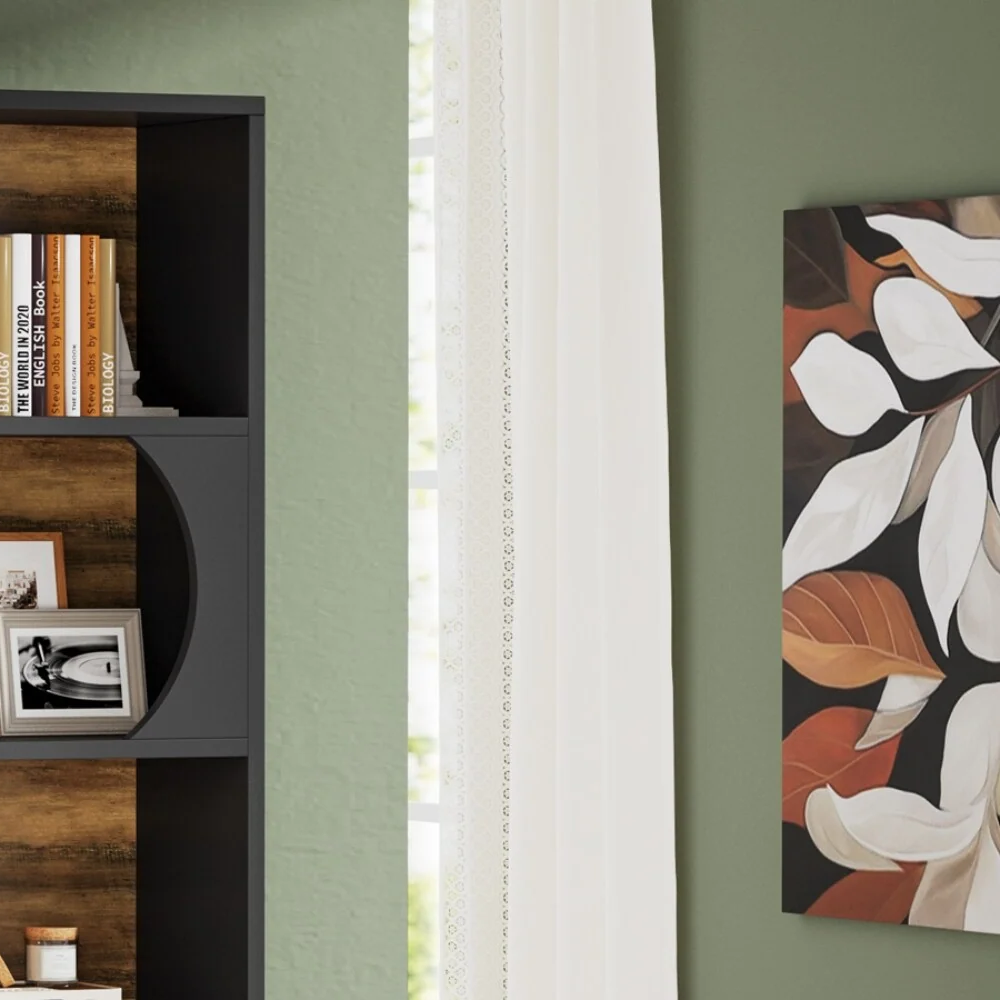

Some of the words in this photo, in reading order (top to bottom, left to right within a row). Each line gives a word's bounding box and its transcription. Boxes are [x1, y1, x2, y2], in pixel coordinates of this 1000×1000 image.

[33, 280, 45, 316] Book
[52, 292, 60, 329] Walter
[86, 292, 96, 329] Walter
[18, 305, 29, 334] 2020
[17, 337, 29, 348] IN
[52, 335, 63, 347] by
[88, 335, 97, 347] by
[33, 325, 45, 387] ENGLISH
[52, 356, 60, 376] Jobs
[88, 356, 96, 376] Jobs
[17, 351, 29, 390] WORLD
[102, 353, 114, 412] BIOLOGY
[17, 393, 29, 413] THE
[51, 385, 60, 413] Steve
[88, 385, 96, 413] Steve
